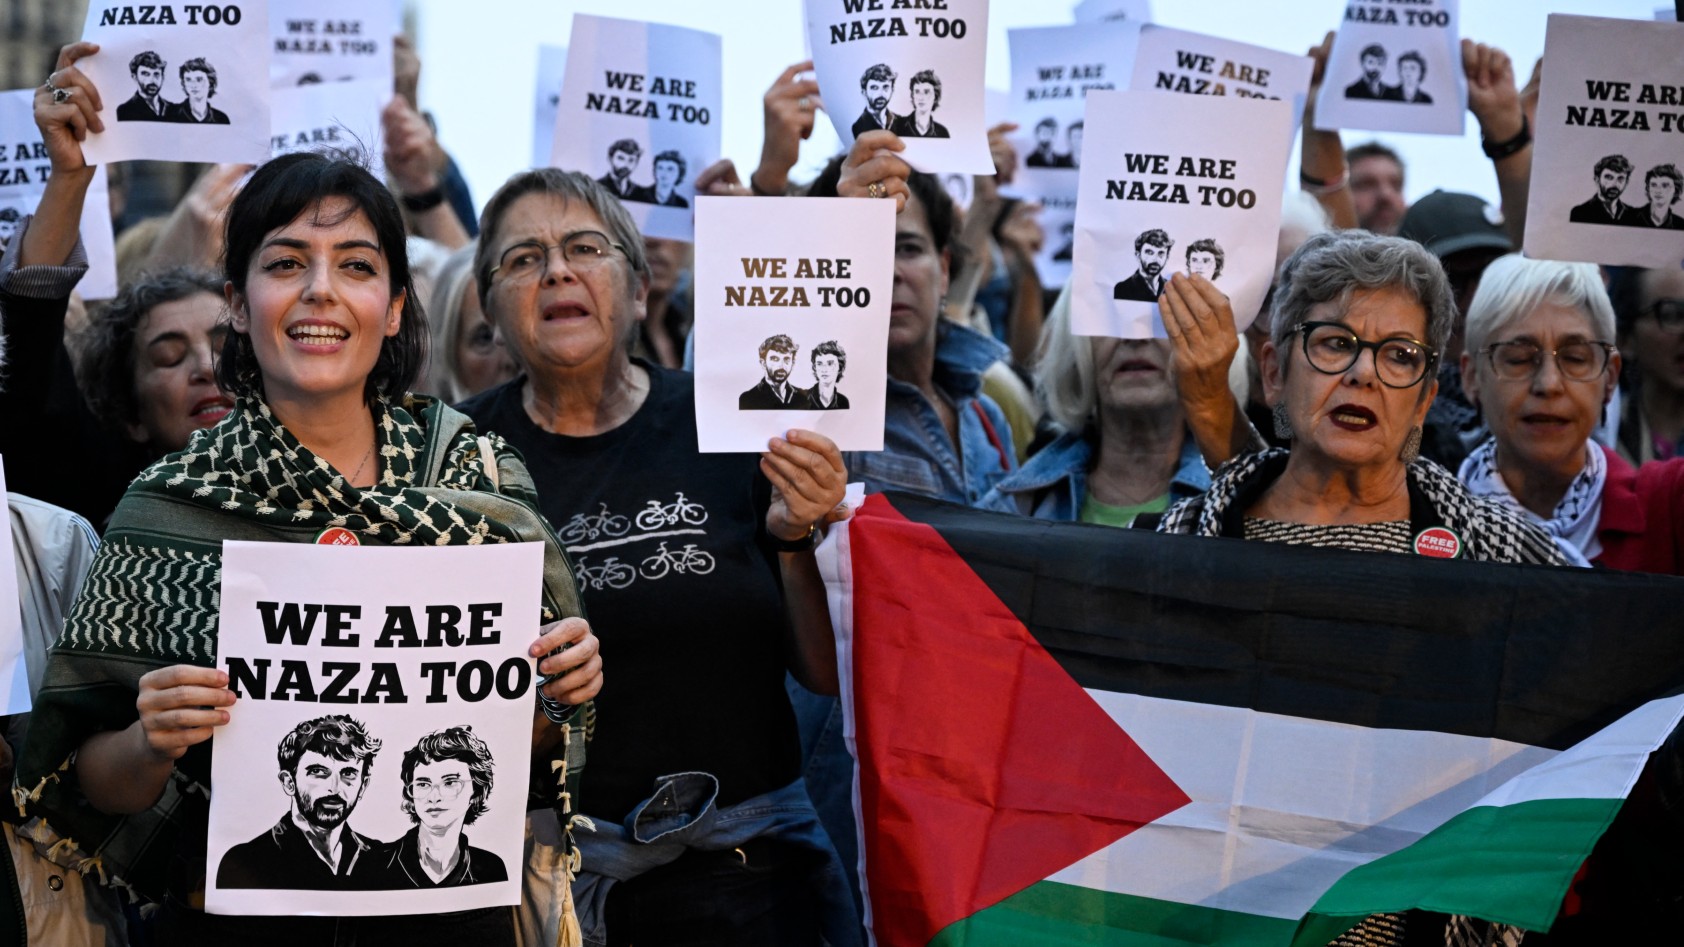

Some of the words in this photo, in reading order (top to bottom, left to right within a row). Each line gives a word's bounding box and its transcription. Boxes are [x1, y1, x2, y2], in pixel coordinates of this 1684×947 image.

[99, 5, 177, 26] NAZA
[184, 5, 241, 26] TOO
[1404, 9, 1450, 27] TOO
[829, 17, 909, 44] NAZA
[915, 17, 967, 39] TOO
[1177, 50, 1215, 74] WE
[1219, 60, 1270, 87] ARE
[605, 70, 644, 92] WE
[649, 77, 697, 98] ARE
[1156, 71, 1226, 96] NAZA
[1586, 80, 1631, 103] WE
[584, 92, 660, 119] NAZA
[667, 103, 710, 125] TOO
[1565, 105, 1651, 131] NAZA
[15, 142, 48, 160] AR
[0, 167, 30, 185] ZA
[1124, 153, 1169, 175] WE
[1175, 157, 1236, 180] ARE
[1105, 180, 1190, 204] NAZA
[1198, 185, 1257, 210] TOO
[741, 258, 787, 278] WE
[794, 258, 851, 279] ARE
[725, 286, 811, 307] NAZA
[817, 286, 871, 308] TOO
[1418, 542, 1455, 554] PALESTINE
[1422, 535, 1455, 548] FREE
[256, 601, 362, 647] WE
[374, 602, 503, 648] ARE
[225, 657, 408, 704] NAZA
[420, 657, 532, 703] TOO
